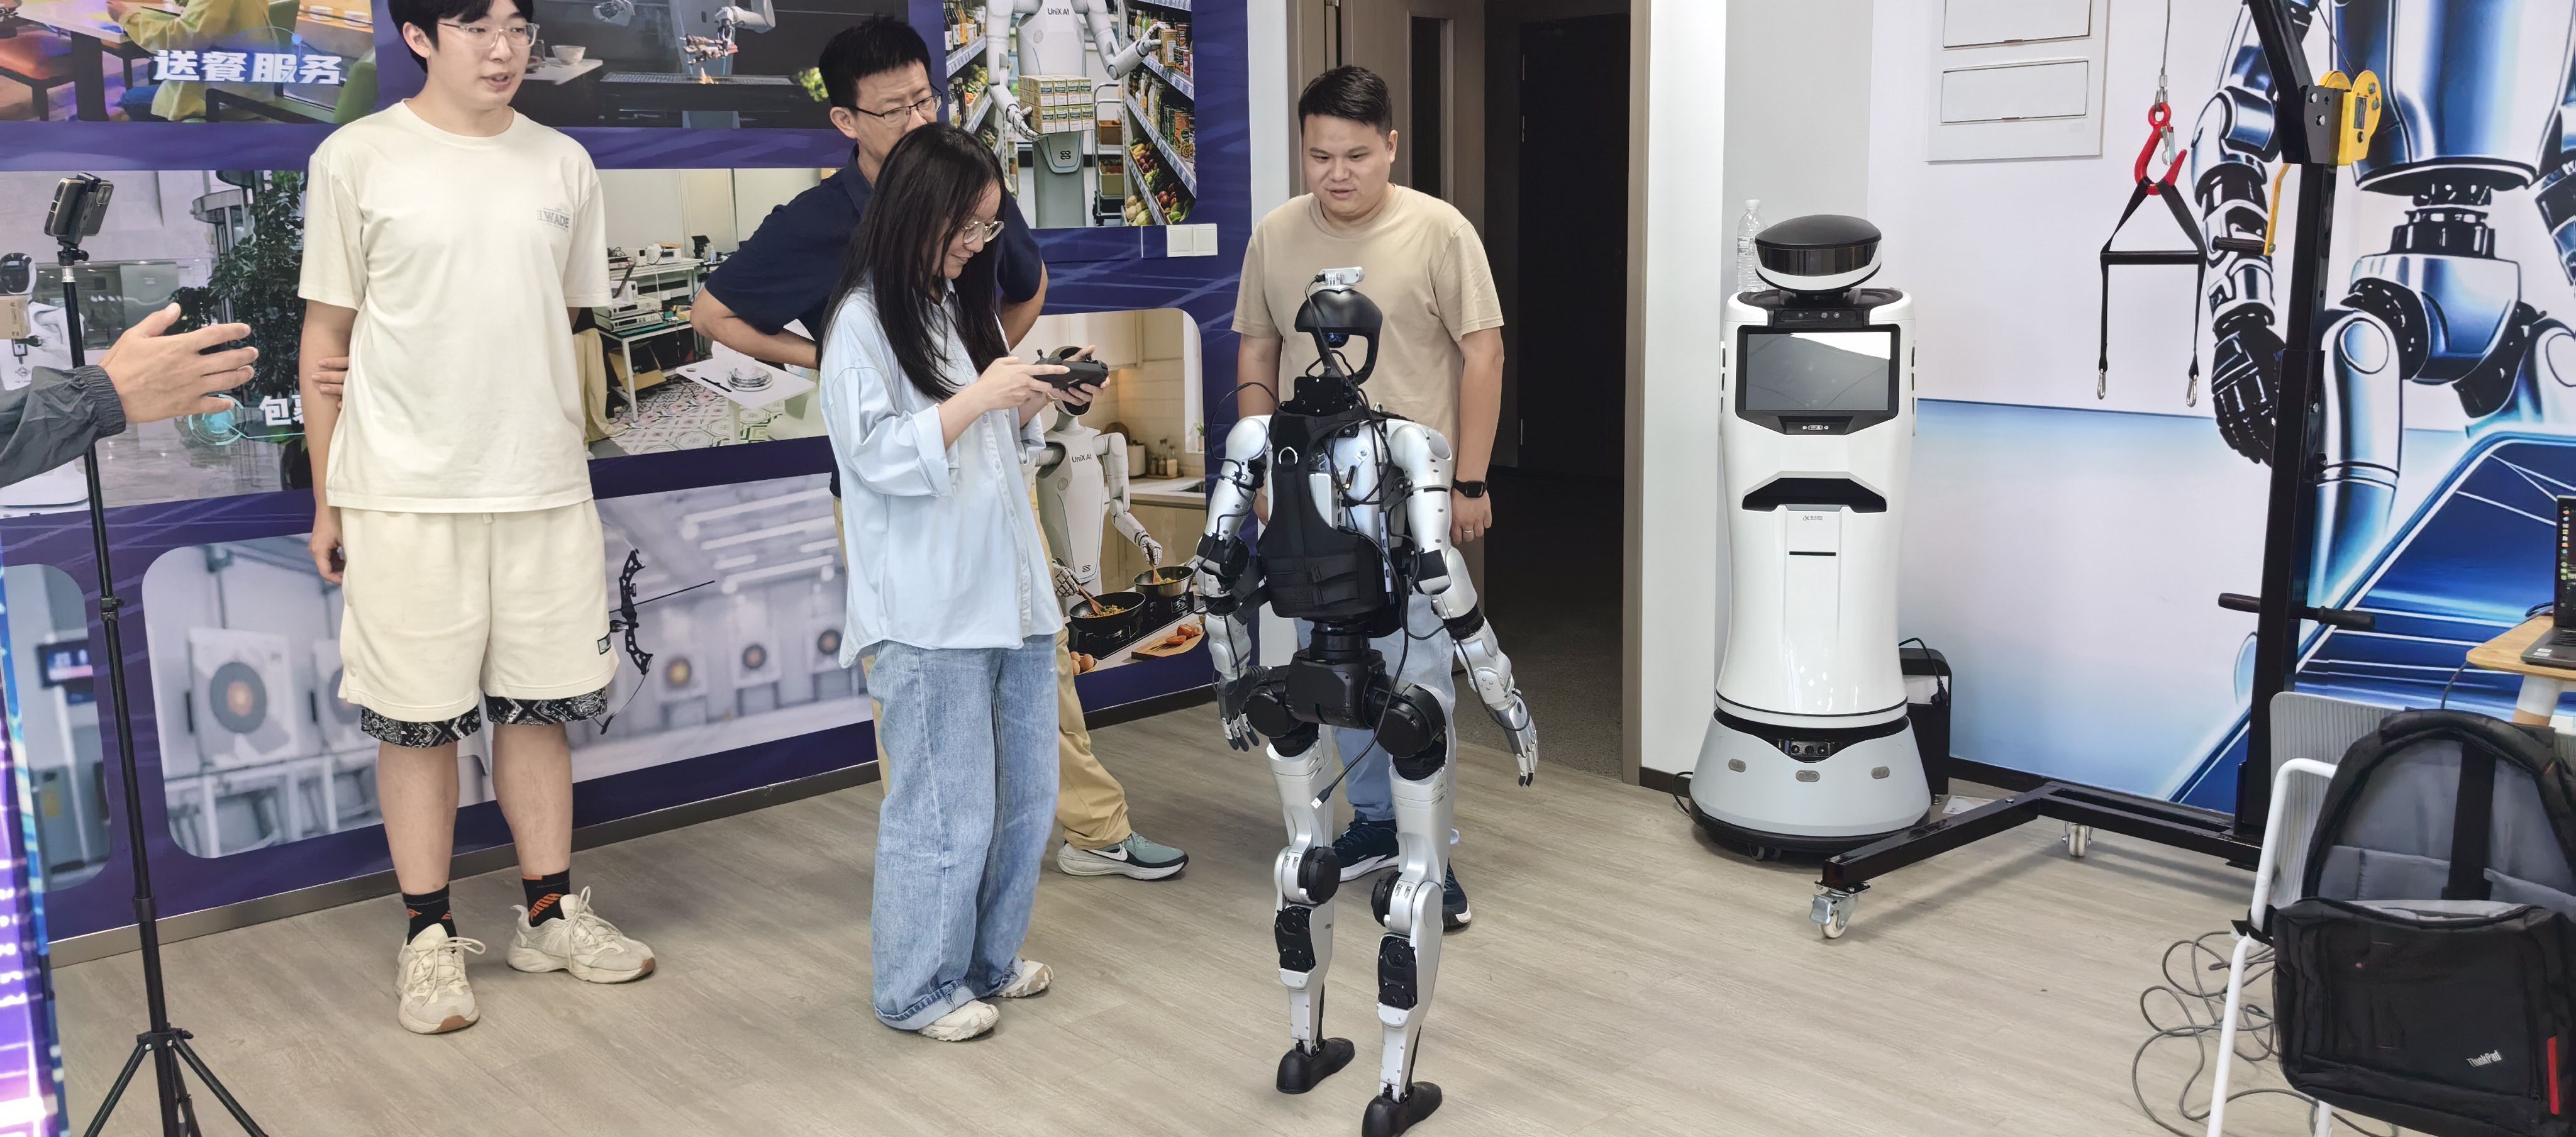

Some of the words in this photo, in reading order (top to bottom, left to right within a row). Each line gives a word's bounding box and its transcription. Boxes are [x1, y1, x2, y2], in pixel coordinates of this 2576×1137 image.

[153, 50, 342, 84] 送餐服务
[1072, 455, 1085, 463] UniX
[2466, 1050, 2502, 1067] ThinkPad
